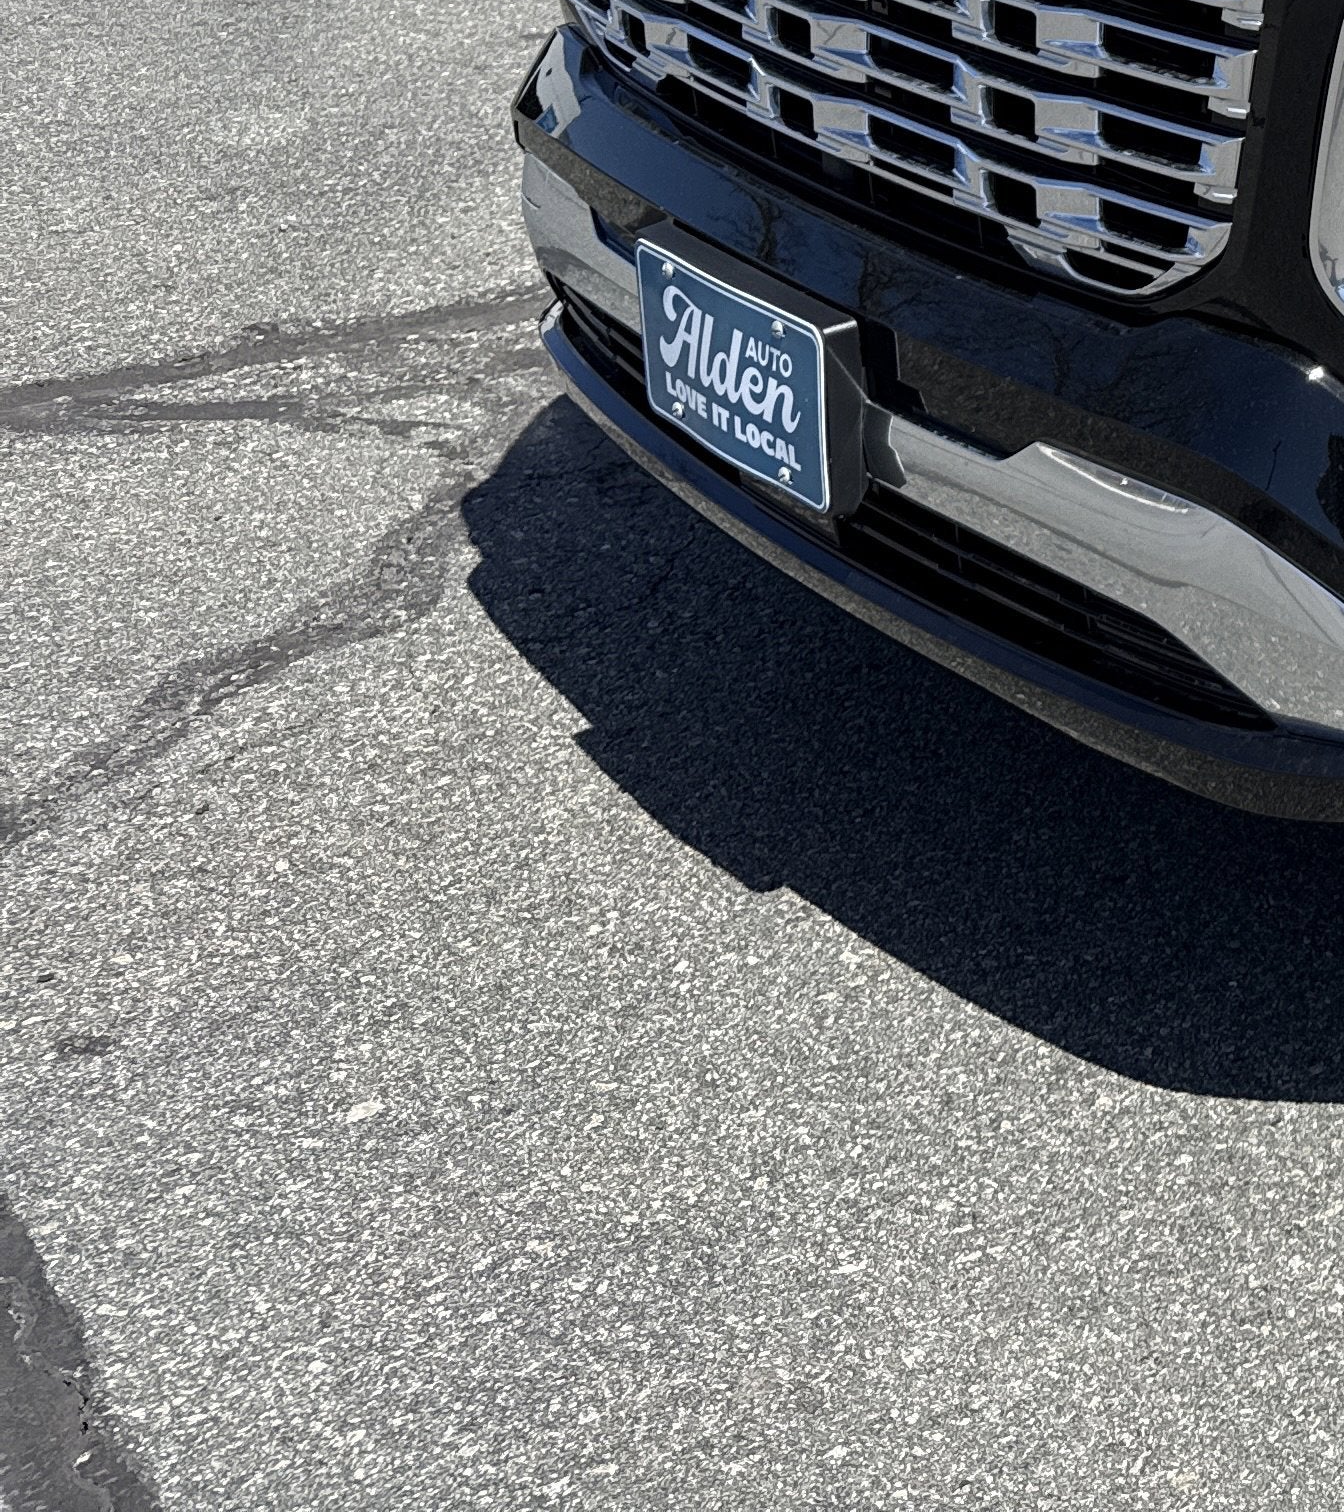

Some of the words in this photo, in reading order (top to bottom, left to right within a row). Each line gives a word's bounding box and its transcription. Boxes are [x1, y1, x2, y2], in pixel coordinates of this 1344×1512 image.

[659, 285, 801, 434] Alden
[745, 337, 793, 378] AUTO
[665, 371, 707, 419] LOVE
[712, 402, 730, 432] IT
[735, 415, 801, 471] LOCAL
